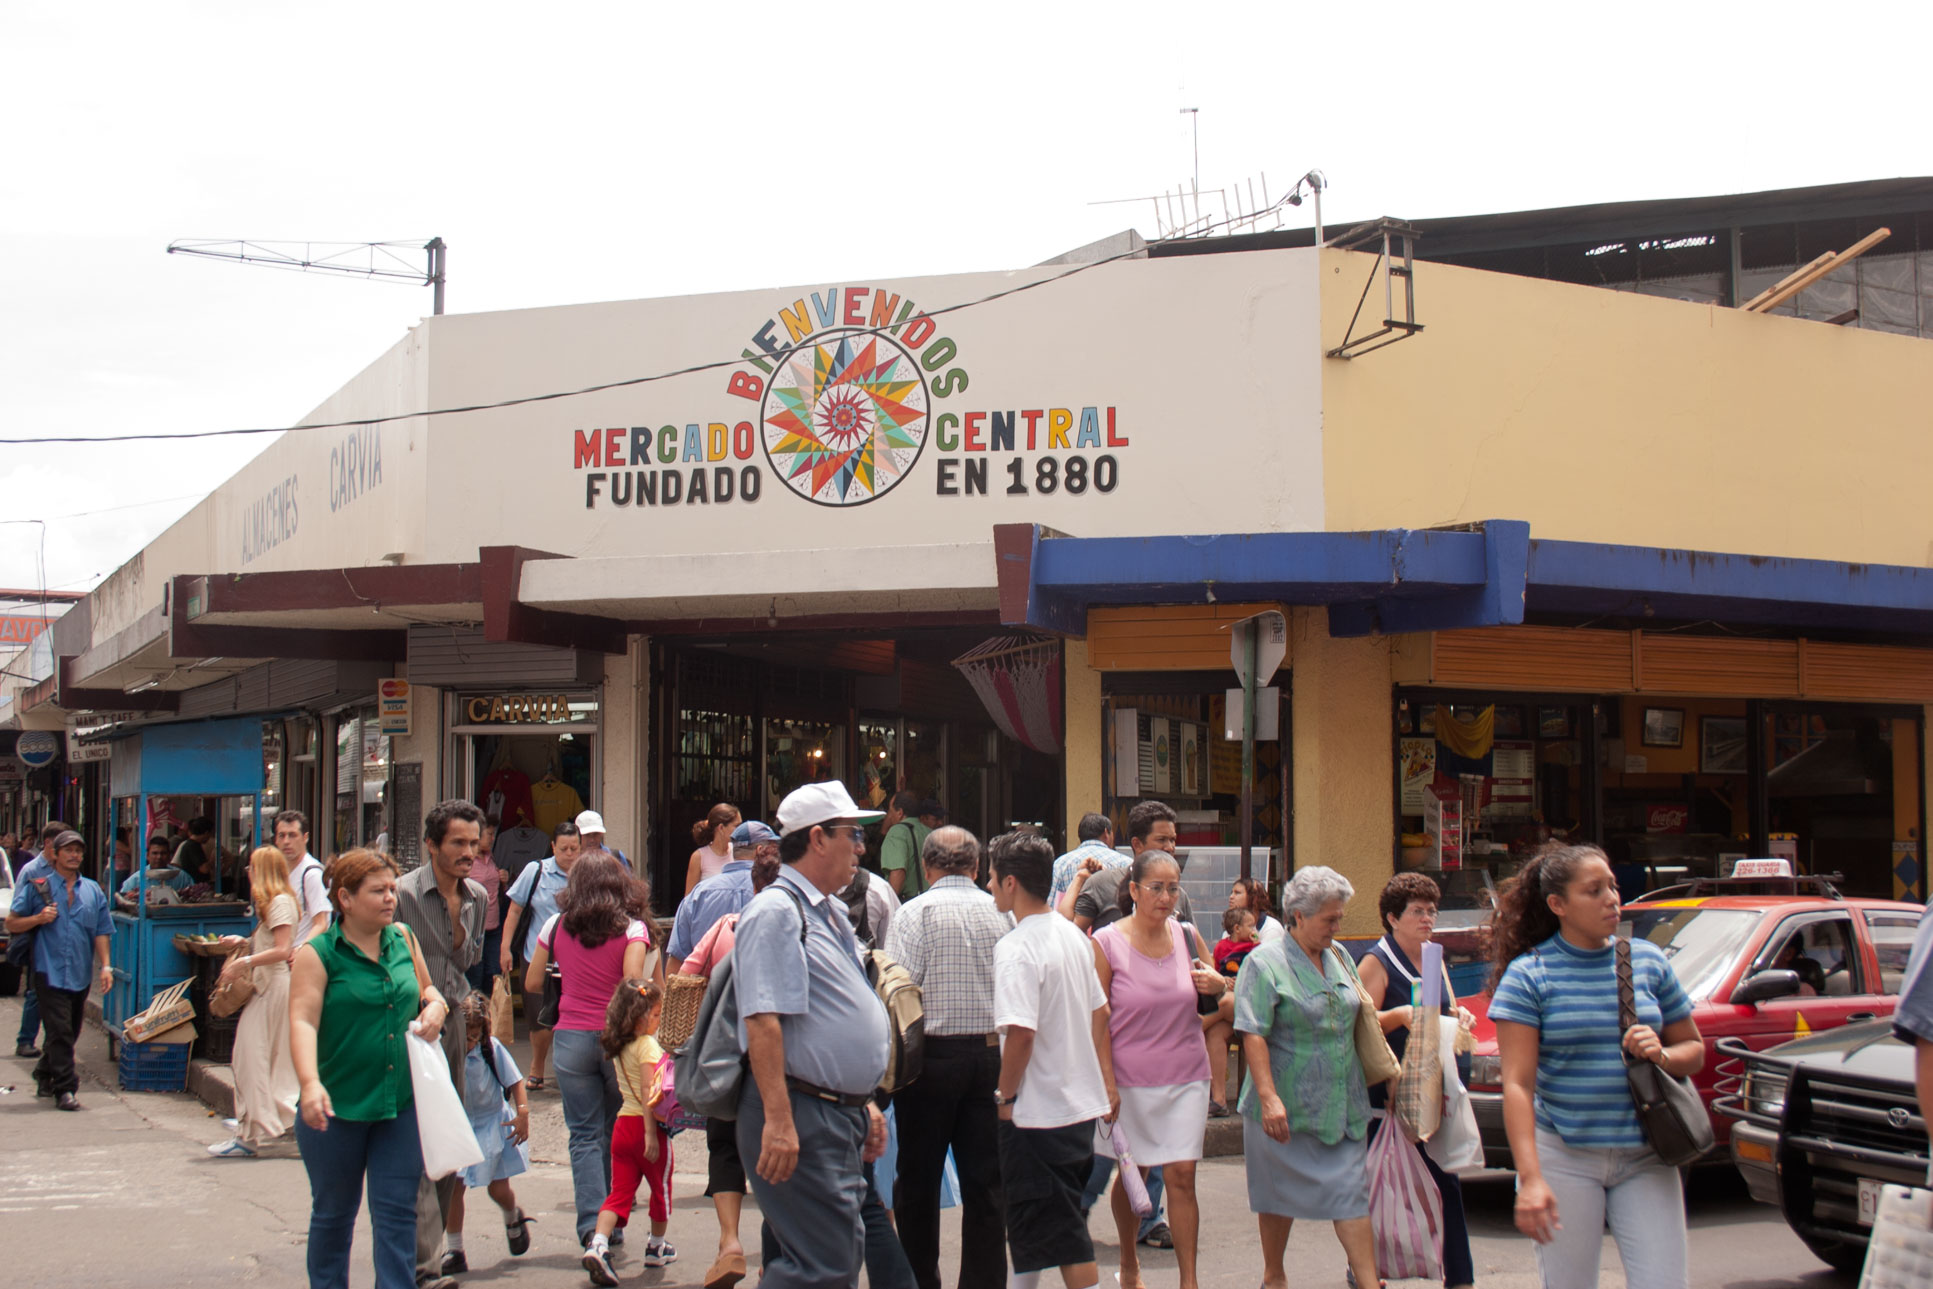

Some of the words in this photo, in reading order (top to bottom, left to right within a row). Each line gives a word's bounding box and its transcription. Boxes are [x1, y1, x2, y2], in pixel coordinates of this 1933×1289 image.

[727, 287, 969, 401] BIENVENIDOS
[574, 421, 755, 469] MERCADO
[936, 407, 1129, 452] CENTRAL
[242, 474, 299, 566] ALMACENES
[330, 416, 382, 513] CARVIA
[586, 465, 762, 509] FUNDADO
[937, 457, 988, 496] EN
[1006, 454, 1118, 495] 1880
[468, 694, 571, 723] CARVIA
